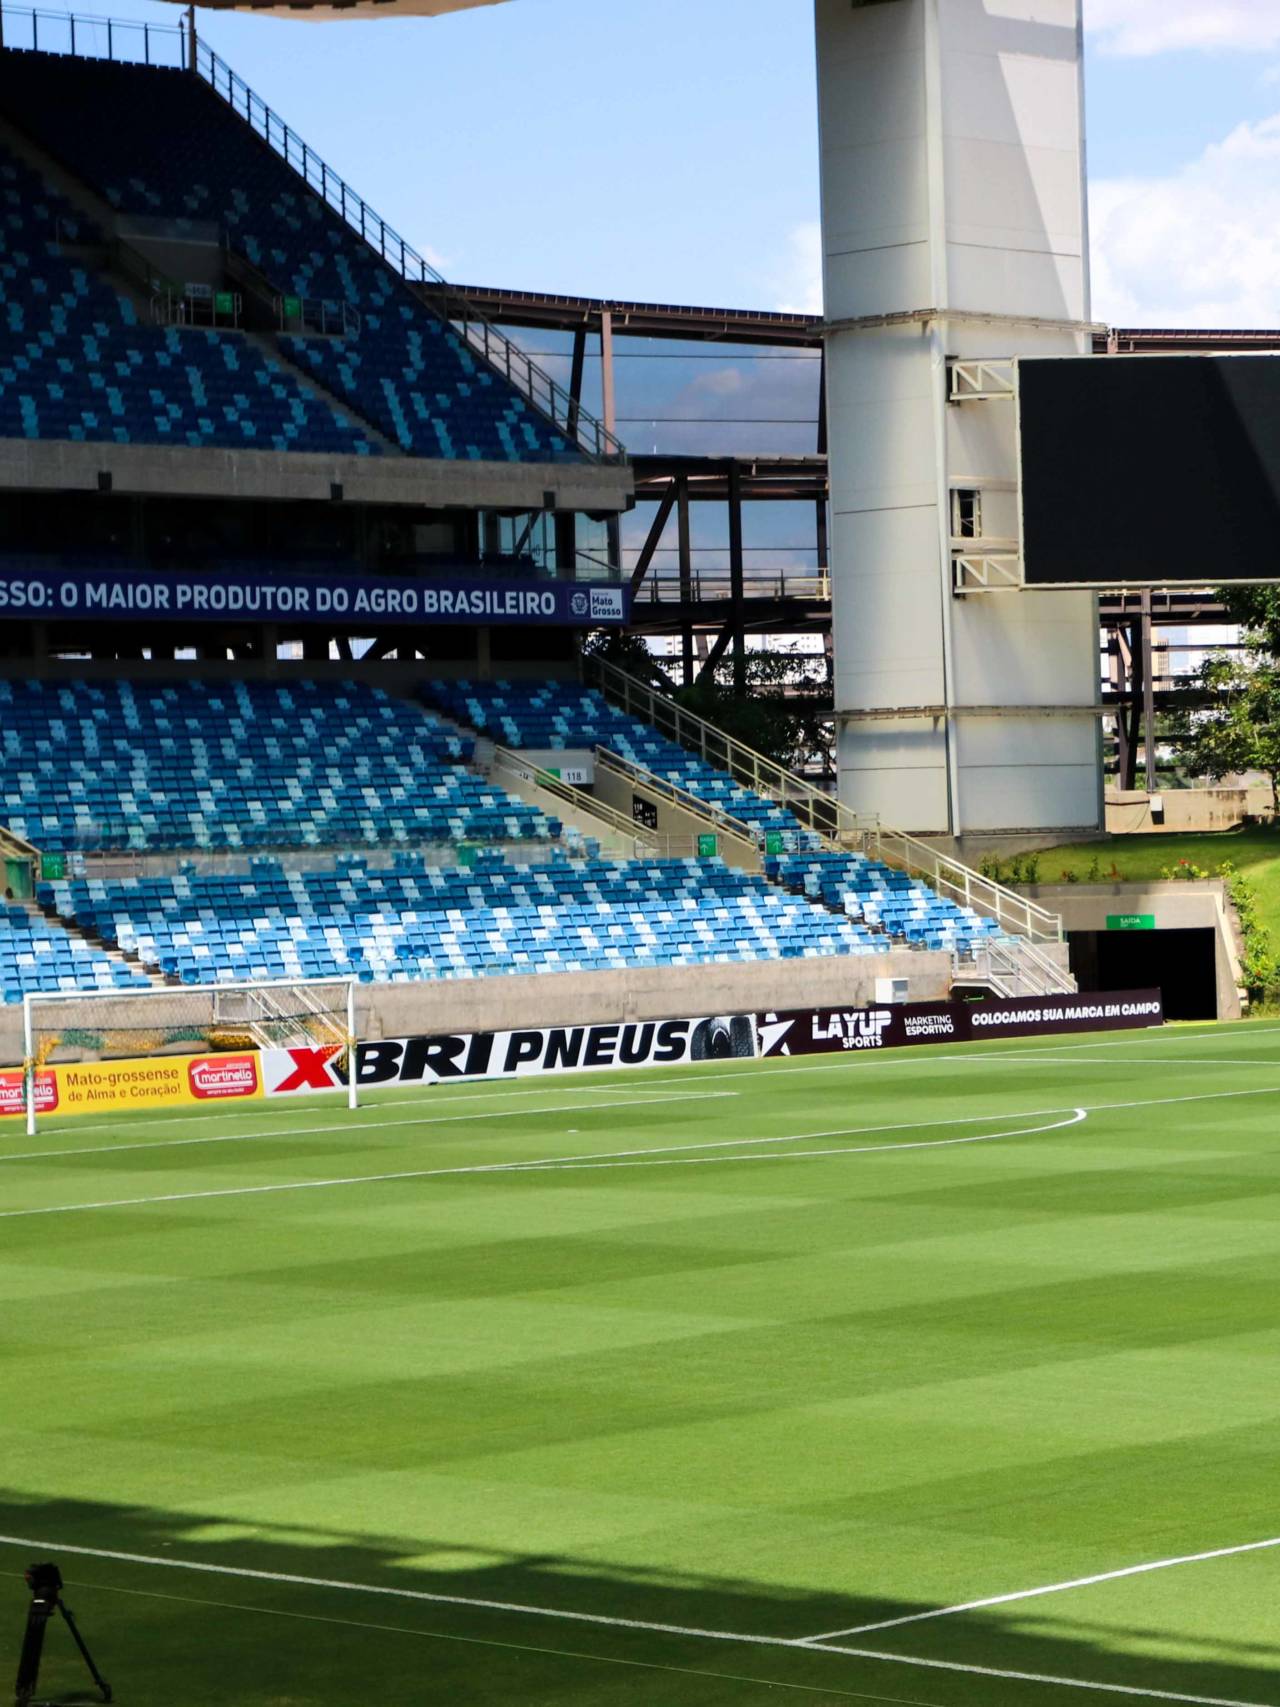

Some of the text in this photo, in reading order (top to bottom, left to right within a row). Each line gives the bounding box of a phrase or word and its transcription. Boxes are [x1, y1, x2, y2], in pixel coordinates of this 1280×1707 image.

[60, 582, 78, 608] O
[85, 583, 170, 609] MAIOR
[176, 584, 310, 611] PRODUTOR
[316, 588, 349, 612] DO
[353, 588, 418, 613] AGRO
[424, 590, 556, 615] BRASILEIRO
[592, 596, 612, 605] Mato
[592, 606, 621, 615] Grosso
[567, 772, 582, 781] 118
[904, 1015, 951, 1026] MARKETING
[971, 1002, 1160, 1026] COLOCAMOS SUA MARCA EM CAMPO
[812, 1010, 892, 1040] LAYUP
[906, 1024, 954, 1036] ESPORTIVO
[503, 1020, 691, 1072] PNEUS
[842, 1035, 883, 1049] SPORTS
[66, 1068, 179, 1087] Mato-grossense
[68, 1083, 182, 1101] de Alma e Coração!
